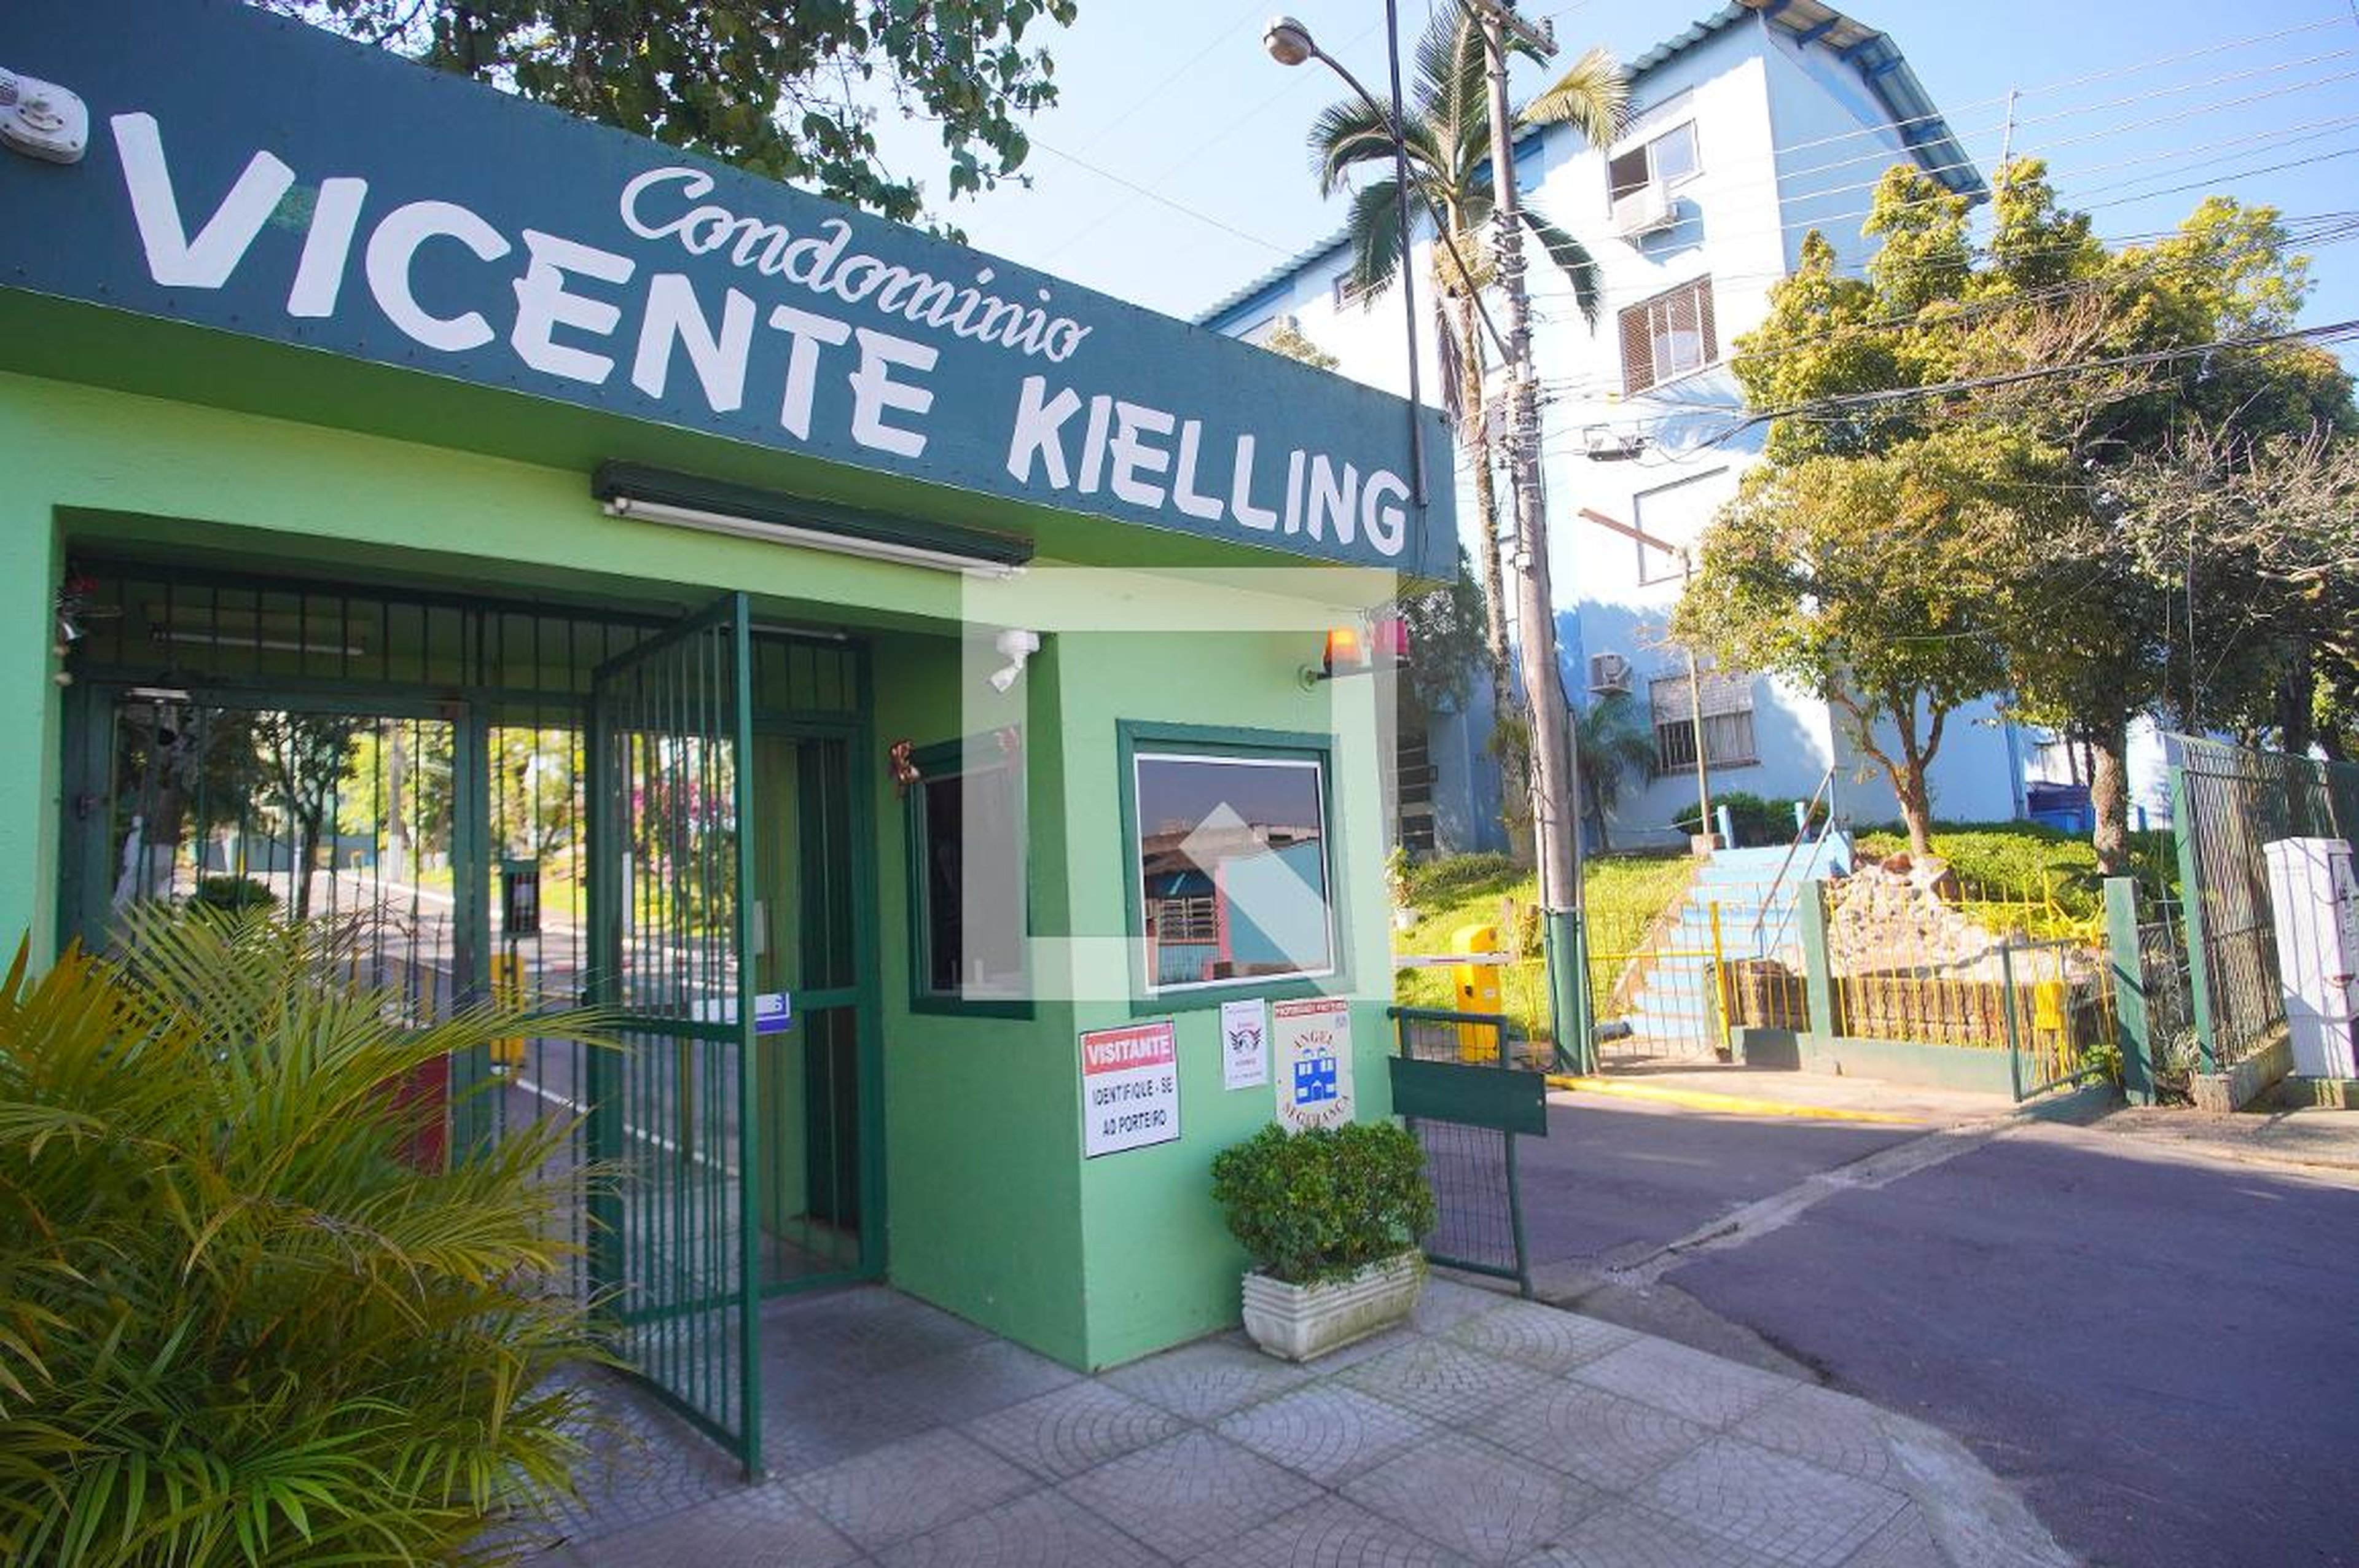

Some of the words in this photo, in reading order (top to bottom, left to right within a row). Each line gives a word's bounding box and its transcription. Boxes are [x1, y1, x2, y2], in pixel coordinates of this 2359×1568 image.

[111, 112, 939, 458] VICENTE
[1007, 375, 1410, 557] KIELLING
[1087, 1035, 1172, 1066] VISITANTE
[1093, 1079, 1153, 1106] IDENTIFIQUE
[1161, 1076, 1173, 1094] SE
[1103, 1118, 1116, 1137] AO
[1119, 1109, 1167, 1134] PORTEIRO
